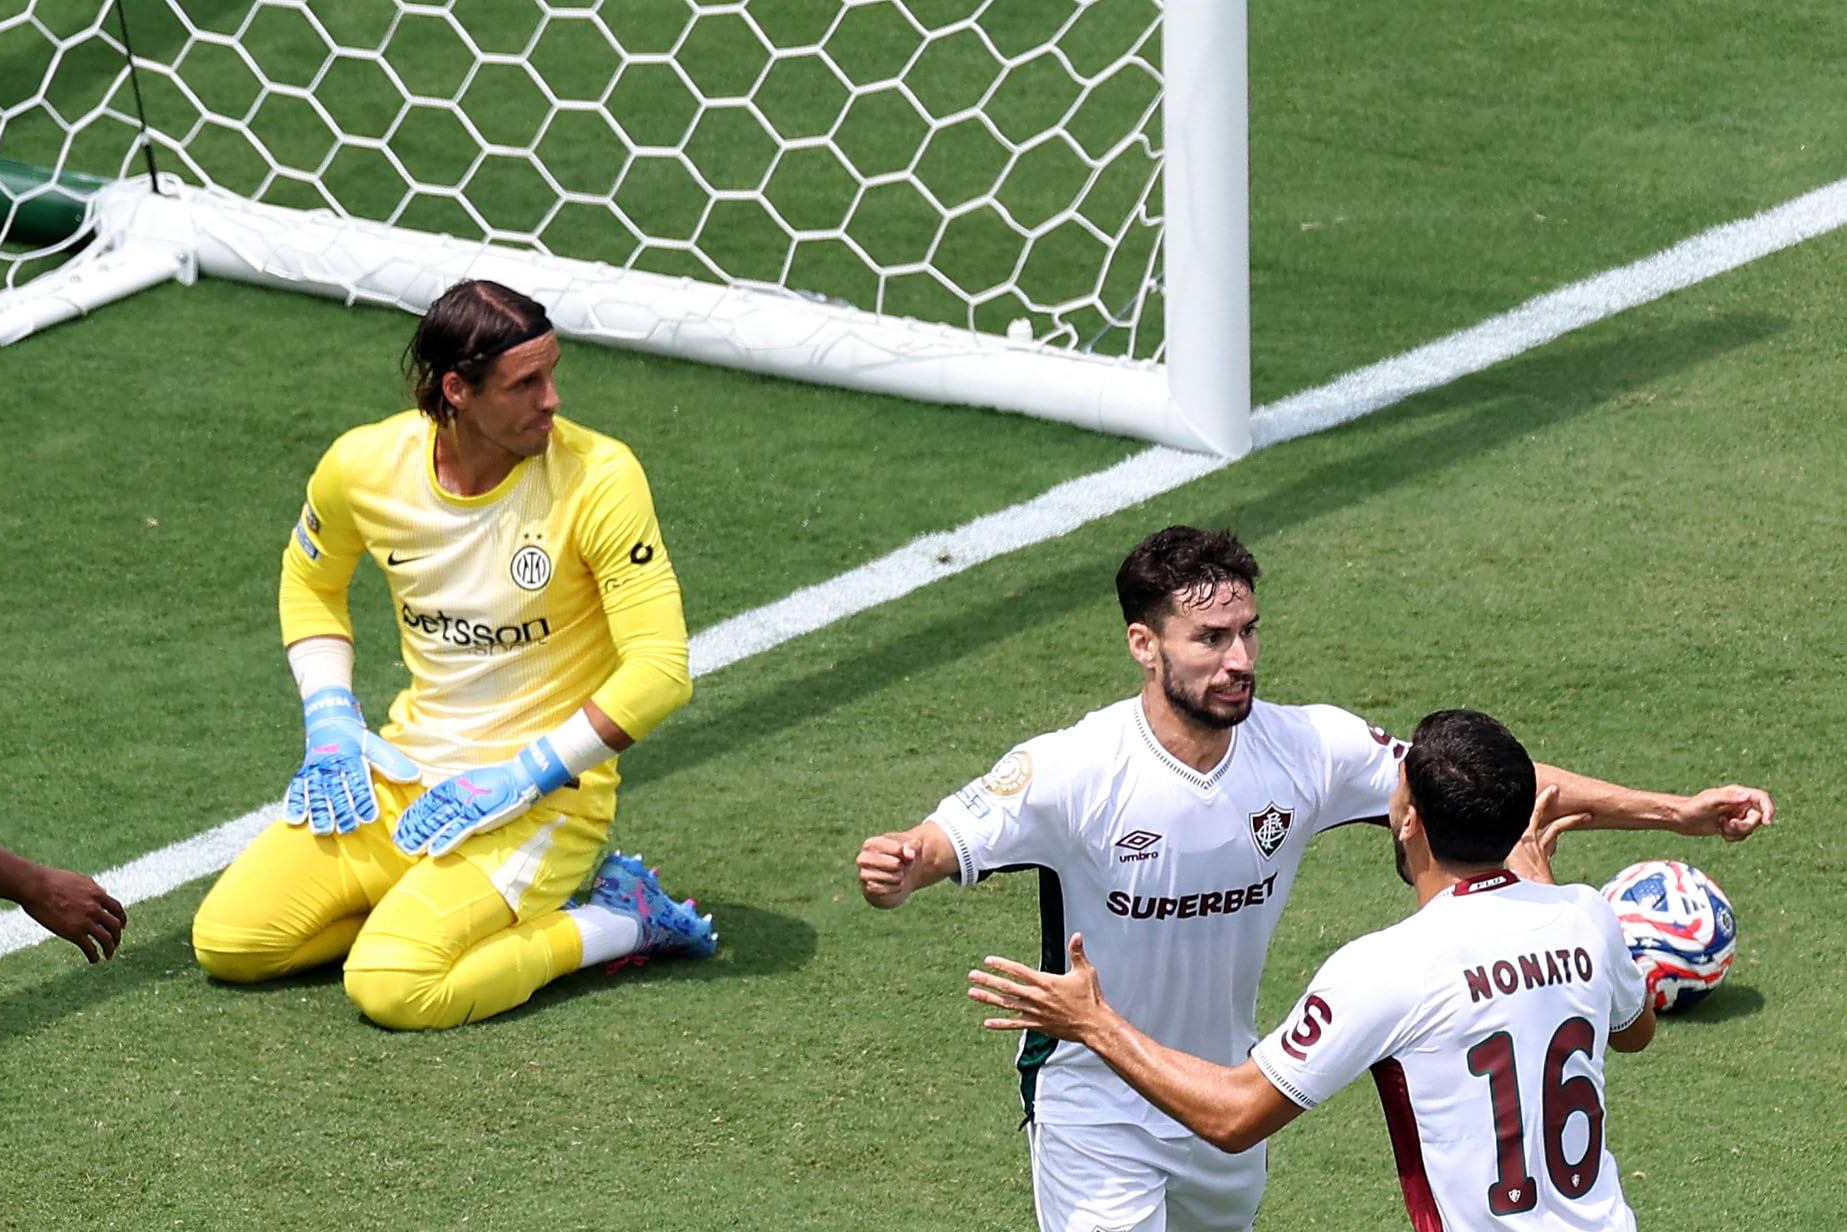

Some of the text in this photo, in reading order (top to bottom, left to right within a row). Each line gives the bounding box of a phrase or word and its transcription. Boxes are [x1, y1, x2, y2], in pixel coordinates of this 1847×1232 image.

[402, 603, 551, 646] betsson
[1119, 850, 1159, 864] umbro
[1106, 871, 1279, 920] SUPERBET
[1463, 946, 1593, 1003] NONATO
[1467, 1016, 1607, 1217] 16
